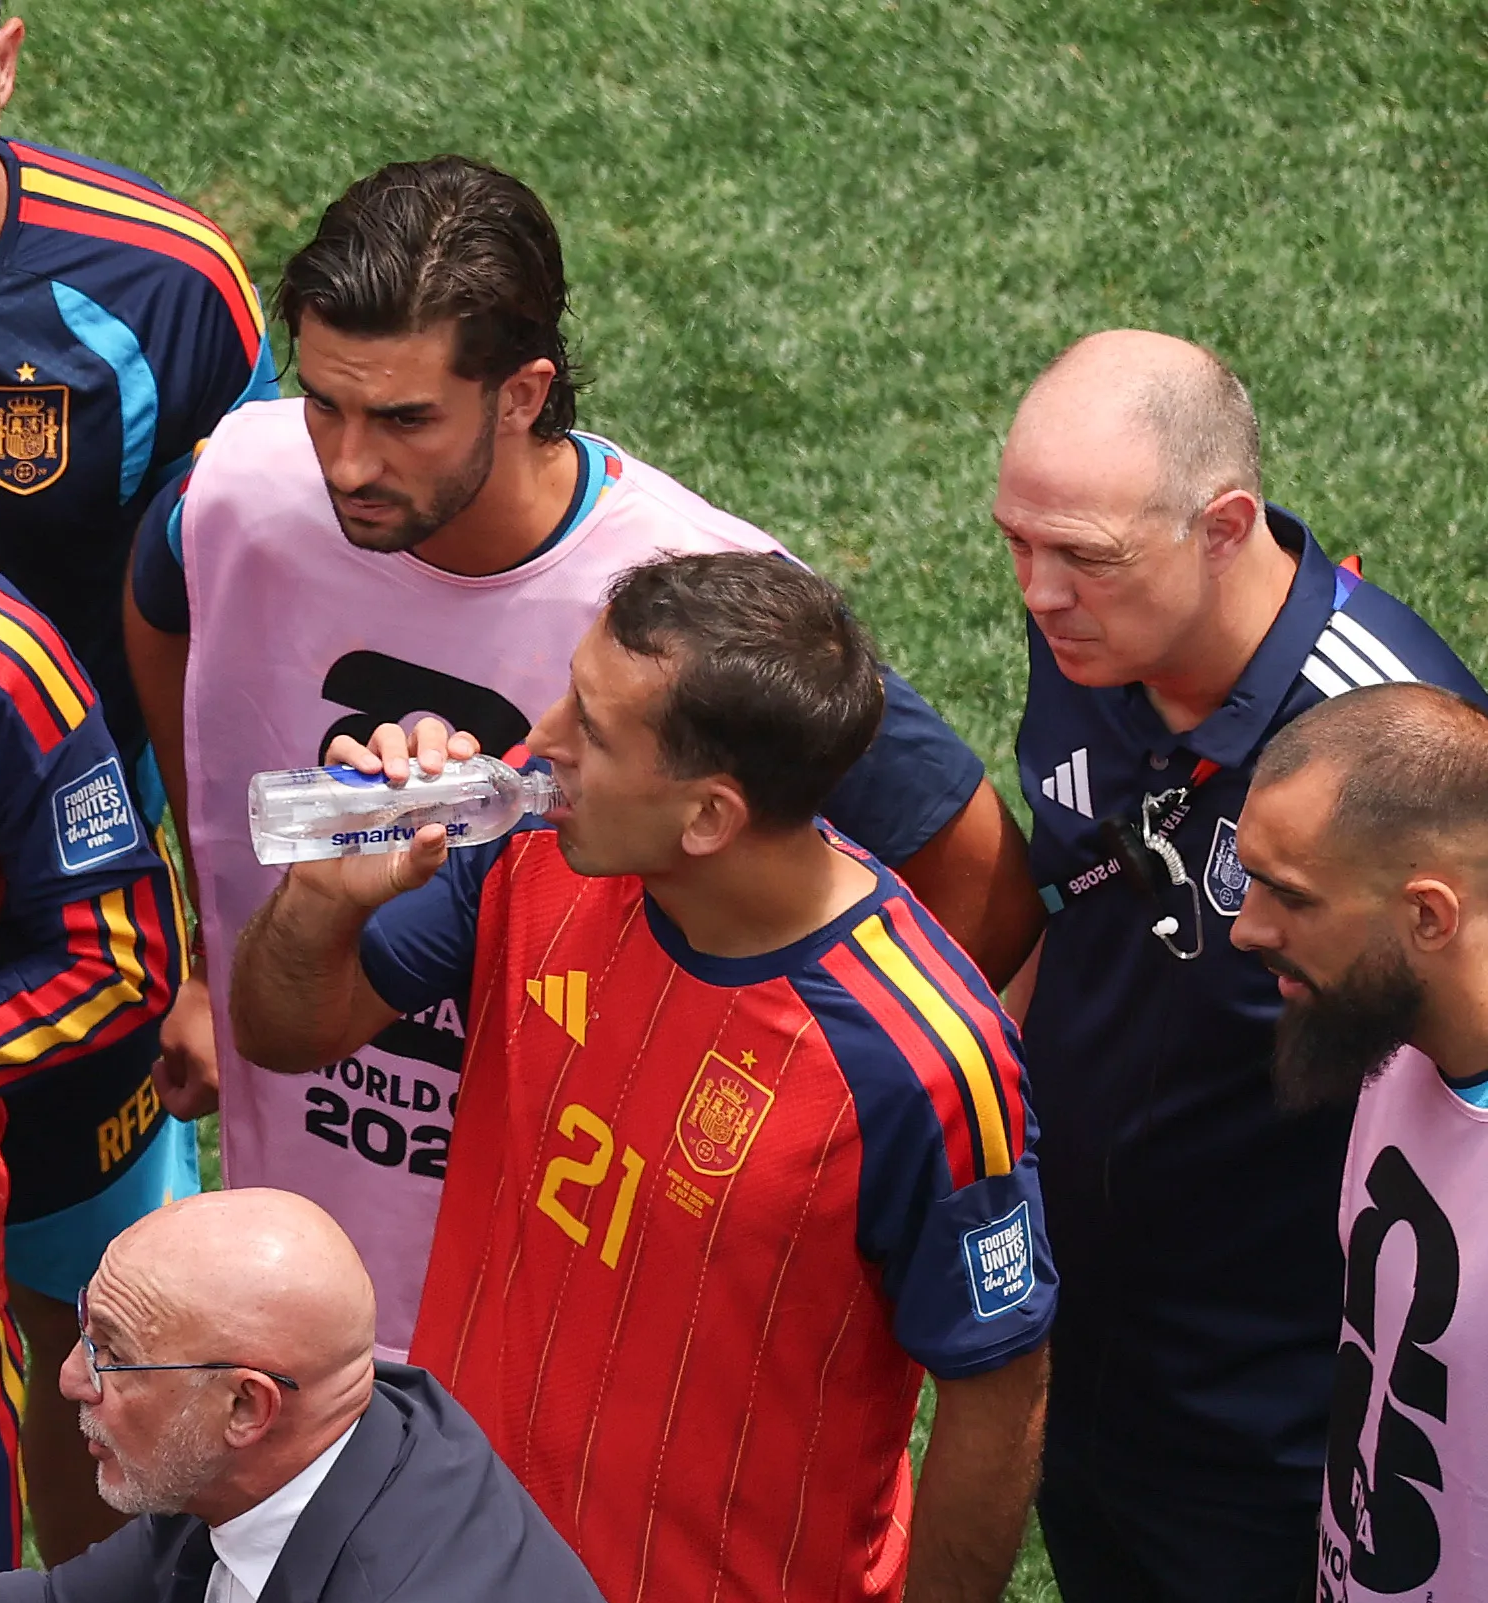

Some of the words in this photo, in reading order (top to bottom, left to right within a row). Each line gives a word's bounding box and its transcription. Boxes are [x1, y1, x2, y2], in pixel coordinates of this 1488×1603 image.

[63, 774, 117, 810] FOOTBALL
[66, 788, 121, 825] UNITES
[65, 824, 89, 844] the
[87, 806, 129, 835] World
[86, 832, 114, 849] FIFA
[1068, 864, 1109, 895] 2026
[536, 1103, 646, 1270] 21
[977, 1218, 1024, 1256] FOOTBALL
[980, 1231, 1025, 1274] UNITES
[981, 1272, 1005, 1293] the
[1002, 1279, 1024, 1297] FIFA
